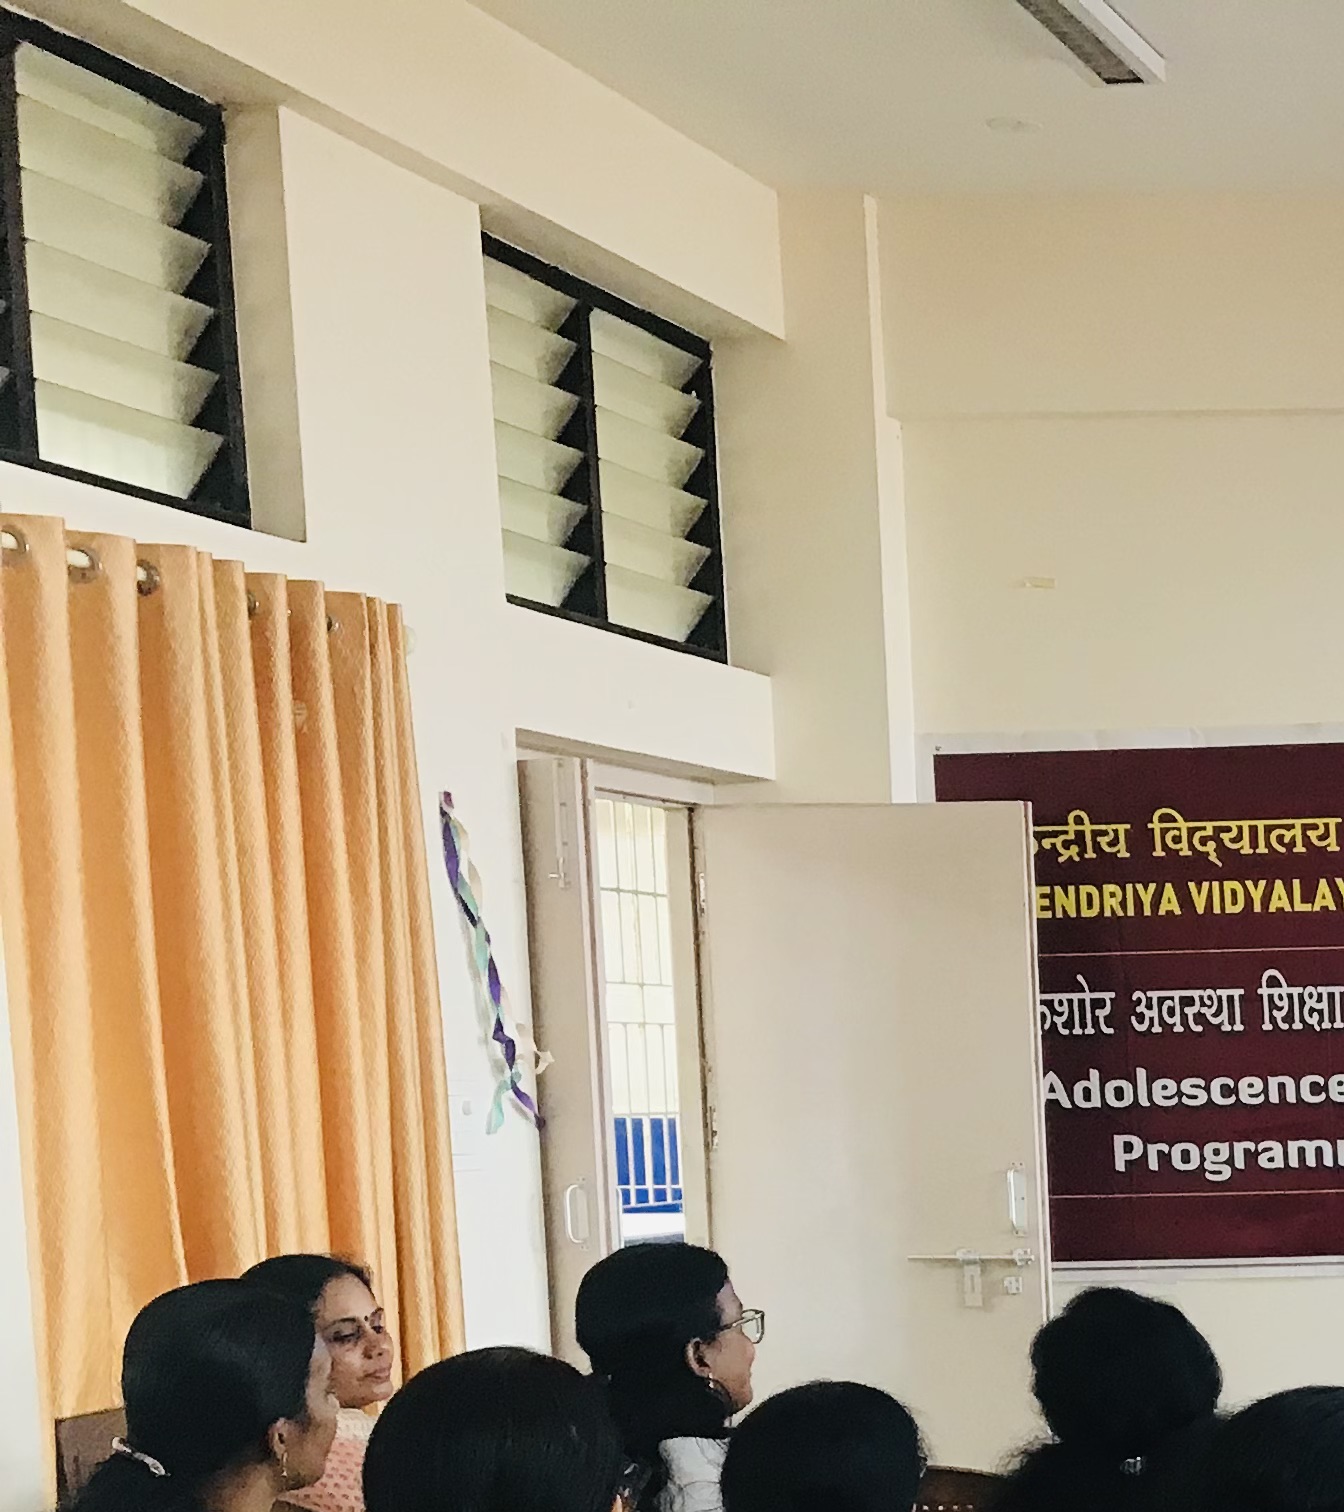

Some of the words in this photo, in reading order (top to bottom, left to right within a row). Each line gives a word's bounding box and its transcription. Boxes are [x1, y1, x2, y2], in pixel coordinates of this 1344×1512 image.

[1033, 809, 1131, 863] न्द्रीय
[1036, 882, 1182, 918] ENDRIYA
[1130, 988, 1245, 1034] अवस्था
[1256, 968, 1344, 1031] शिक्षा
